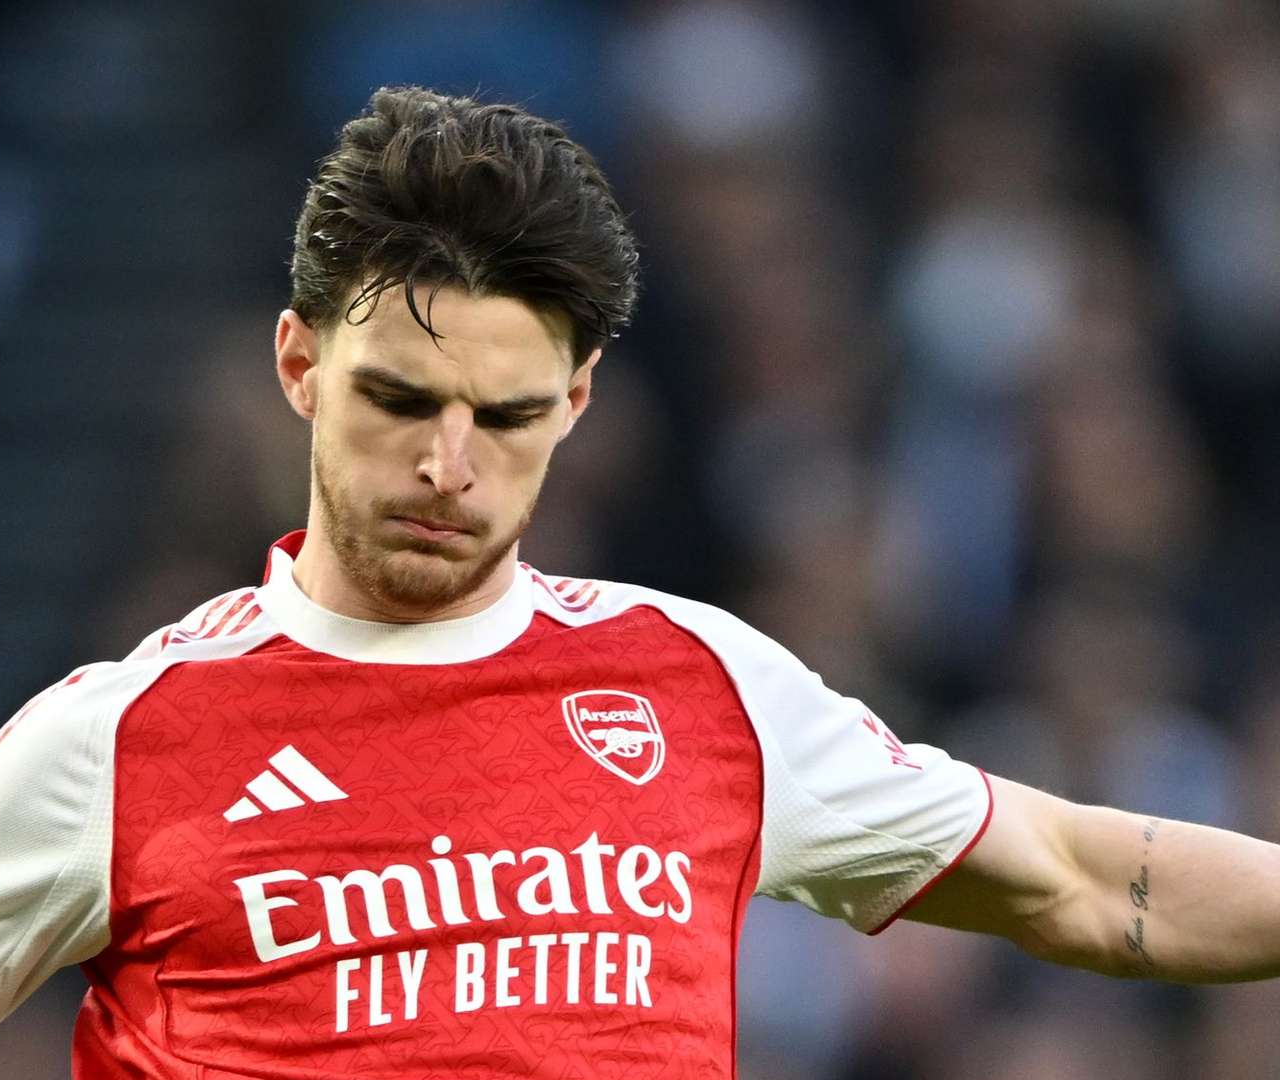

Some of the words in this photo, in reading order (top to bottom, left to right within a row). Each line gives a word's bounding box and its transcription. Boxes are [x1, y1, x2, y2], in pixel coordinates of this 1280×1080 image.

[578, 707, 646, 724] Arsenal
[232, 831, 693, 963] Emirates
[335, 949, 428, 1033] FLY
[455, 932, 652, 1013] BETTER
